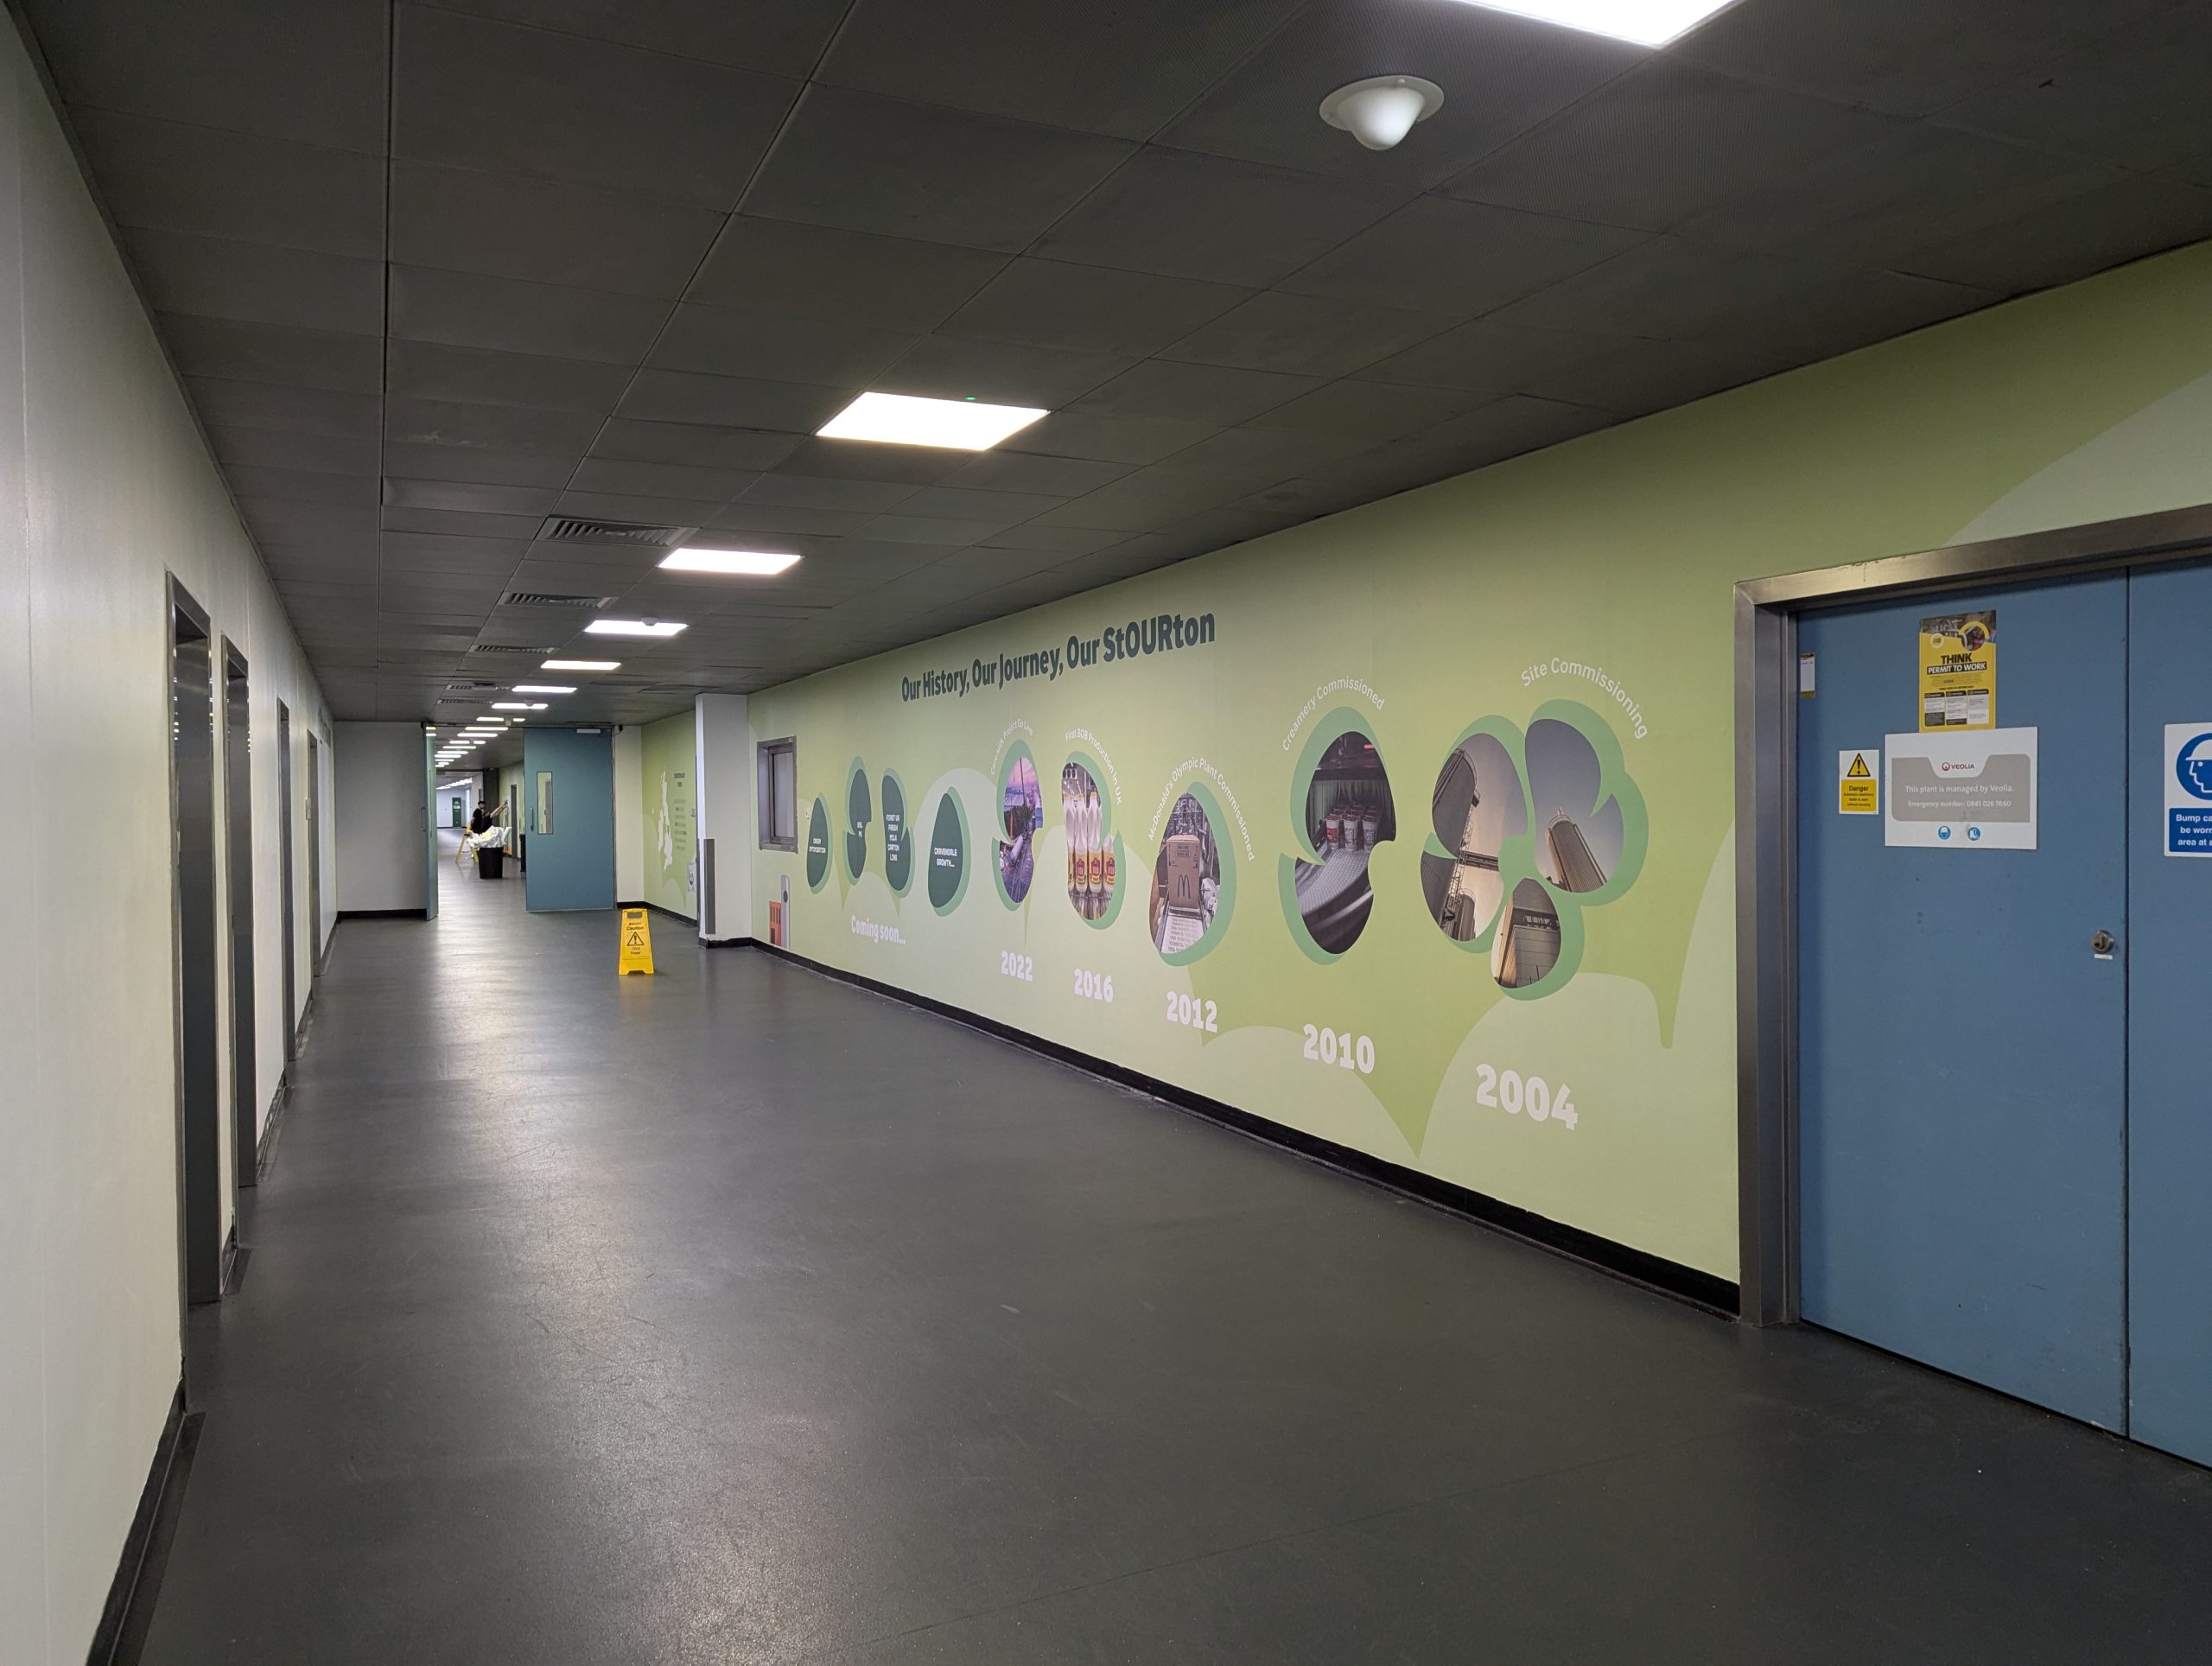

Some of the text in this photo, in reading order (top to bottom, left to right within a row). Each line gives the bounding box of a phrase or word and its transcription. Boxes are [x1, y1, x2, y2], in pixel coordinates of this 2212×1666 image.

[902, 613, 1215, 702] Our History, Our Journey, Our StOURton
[1928, 665, 1952, 674] PERMIT
[1963, 662, 1986, 671] WORK
[1941, 653, 1972, 664] THINK
[1282, 675, 1385, 751] Creamery Commissioned
[1521, 658, 1648, 740] Site Commissioning
[1088, 732, 1114, 773] Production
[1115, 786, 1123, 804] UK
[1920, 785, 1937, 794] plant
[1946, 785, 1978, 794] managed
[1980, 785, 1988, 794] by
[1990, 784, 2015, 792] Veolia.
[1147, 780, 1173, 842] McDonald's
[1172, 757, 1198, 782] Olympic
[1198, 758, 1217, 779] Plant
[1217, 773, 1255, 861] Commissioned
[2176, 814, 2201, 823] Bump
[2180, 825, 2191, 834] be
[851, 915, 879, 943] Coming
[1001, 951, 1033, 982] 2022
[1074, 969, 1113, 1002] 2016
[1166, 991, 1217, 1033] 2012
[1303, 1024, 1375, 1074] 2010
[1476, 1064, 1578, 1130] 2004
